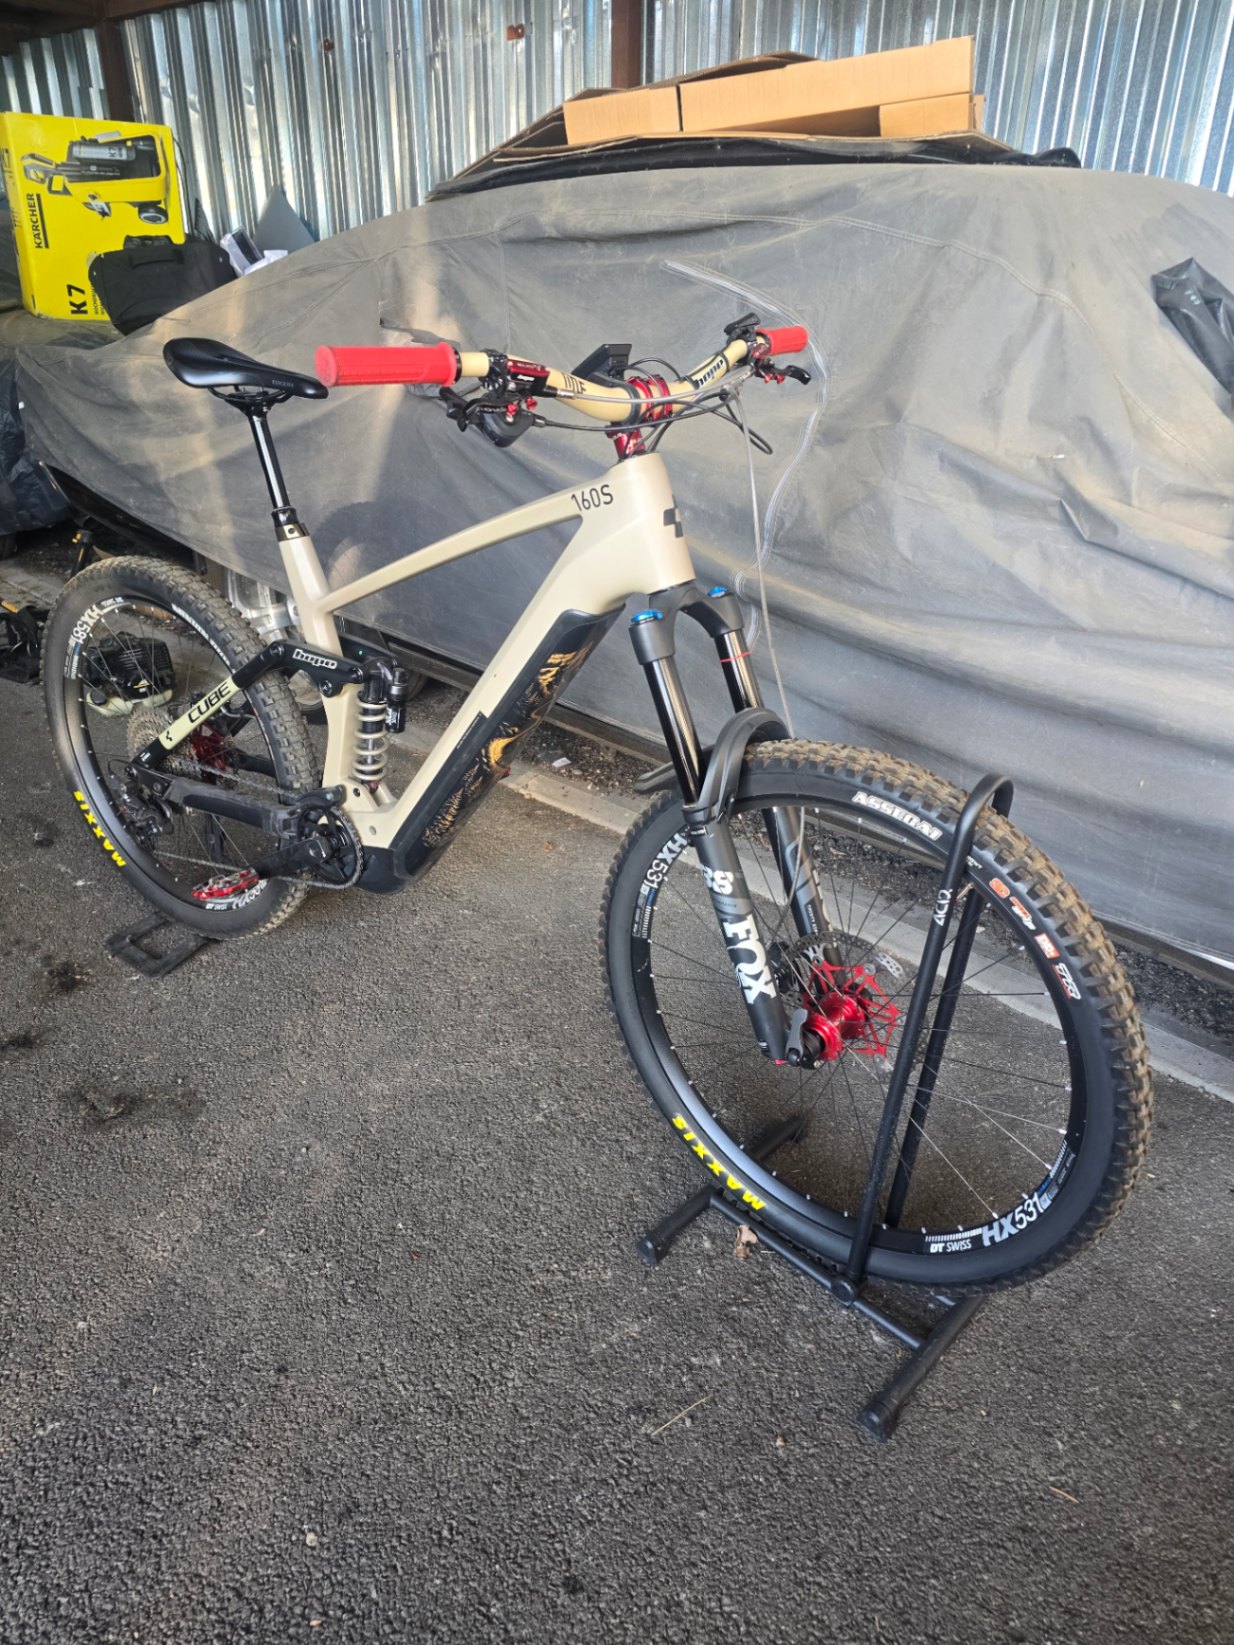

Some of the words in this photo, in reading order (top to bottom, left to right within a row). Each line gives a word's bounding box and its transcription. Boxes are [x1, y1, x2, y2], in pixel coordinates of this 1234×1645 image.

[571, 484, 614, 512] 160S
[292, 648, 338, 670] hope
[188, 682, 232, 724] CUBE
[73, 790, 127, 867] MAXXIS
[851, 791, 943, 841] ASSEGAI
[643, 833, 689, 889] HX531
[722, 914, 777, 1005] FOX
[672, 1112, 767, 1210] MAXXIS
[930, 1243, 945, 1253] DT
[946, 1239, 972, 1252] SWISS
[982, 1192, 1044, 1247] HX531
